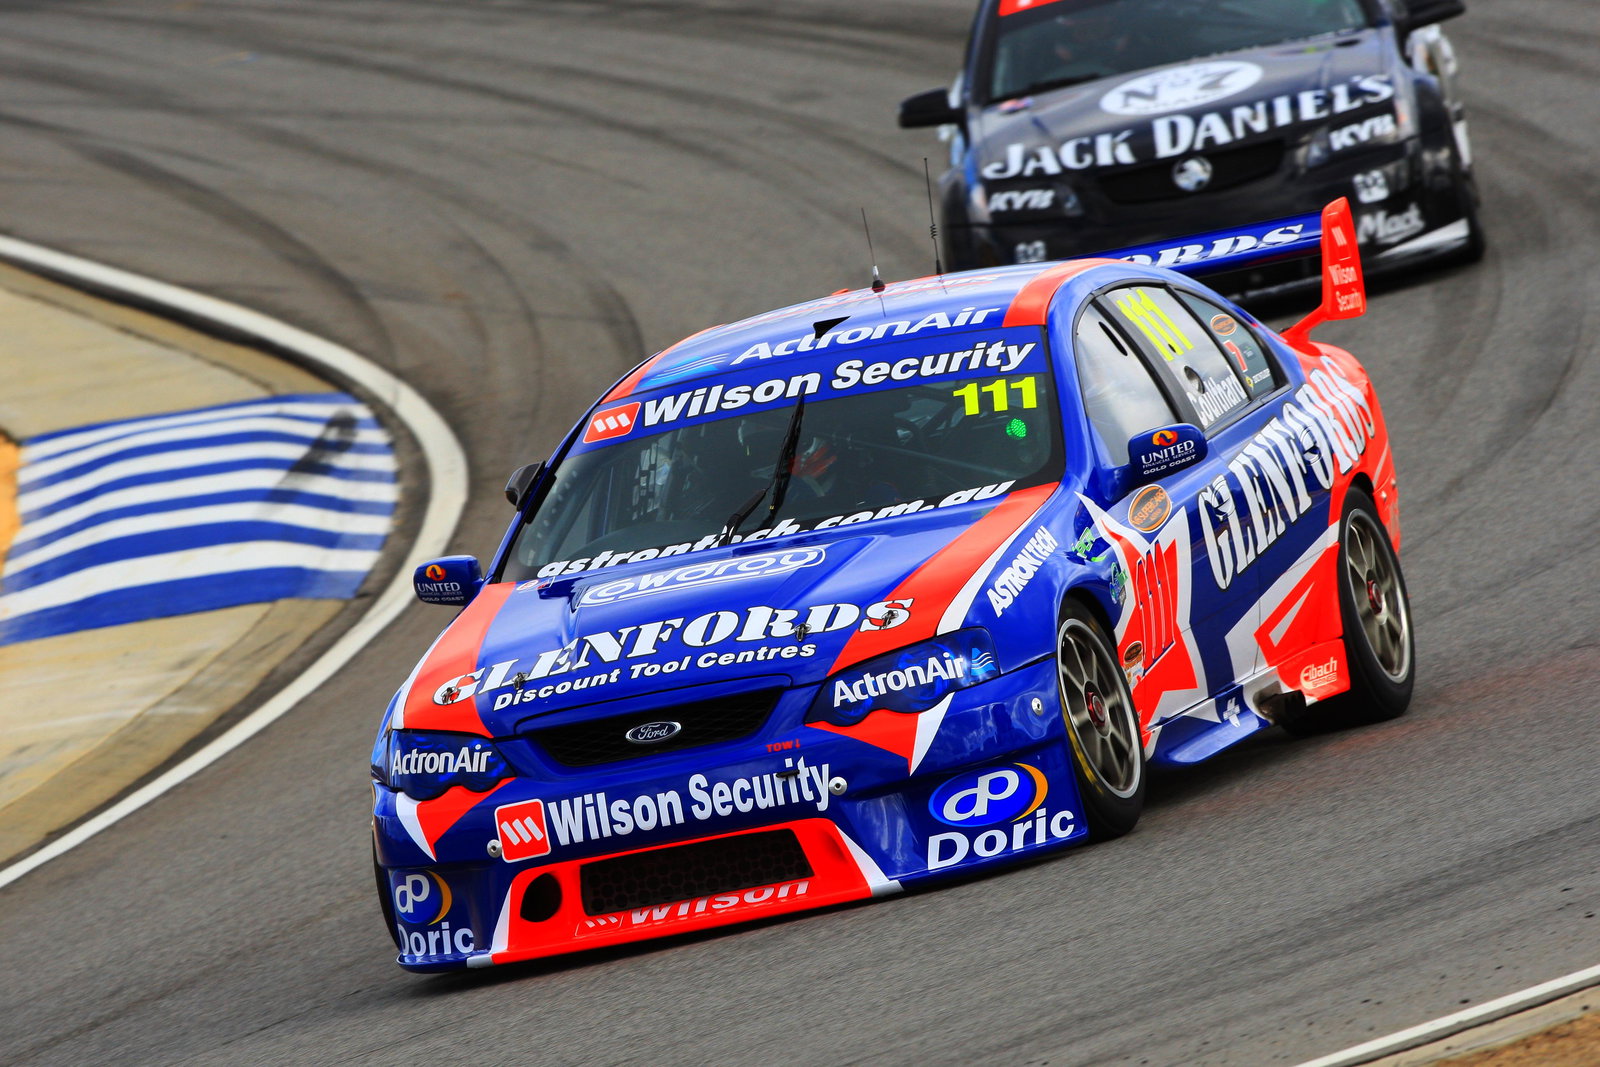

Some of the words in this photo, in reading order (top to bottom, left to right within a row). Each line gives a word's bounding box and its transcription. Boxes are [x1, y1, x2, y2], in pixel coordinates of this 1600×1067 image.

[981, 129, 1137, 180] JACK
[1152, 73, 1394, 159] DANIEL'S
[1328, 265, 1358, 286] Wilson
[729, 306, 1001, 365] ActronAir
[1116, 288, 1195, 362] 111
[643, 371, 822, 427] Wilson
[831, 340, 1037, 391] Security
[953, 376, 1038, 416] 111
[1141, 440, 1195, 464] UNITED
[1143, 465, 1167, 475] GOLD
[1169, 454, 1197, 467] COAST
[1198, 355, 1375, 590] GLENFORDS
[417, 582, 460, 592] UNITED
[986, 525, 1059, 618] ASTRONTECH
[432, 598, 915, 706] GLENFORDS
[493, 668, 621, 712] Discount
[630, 655, 692, 680] Tool
[697, 643, 817, 668] Centres
[833, 651, 964, 708] ActronAir
[1300, 657, 1338, 690] Eibach
[391, 744, 493, 776] ActronAir
[637, 724, 669, 740] Ford
[547, 790, 685, 846] Wilson
[688, 756, 830, 821] Security
[927, 807, 1075, 871] Doric
